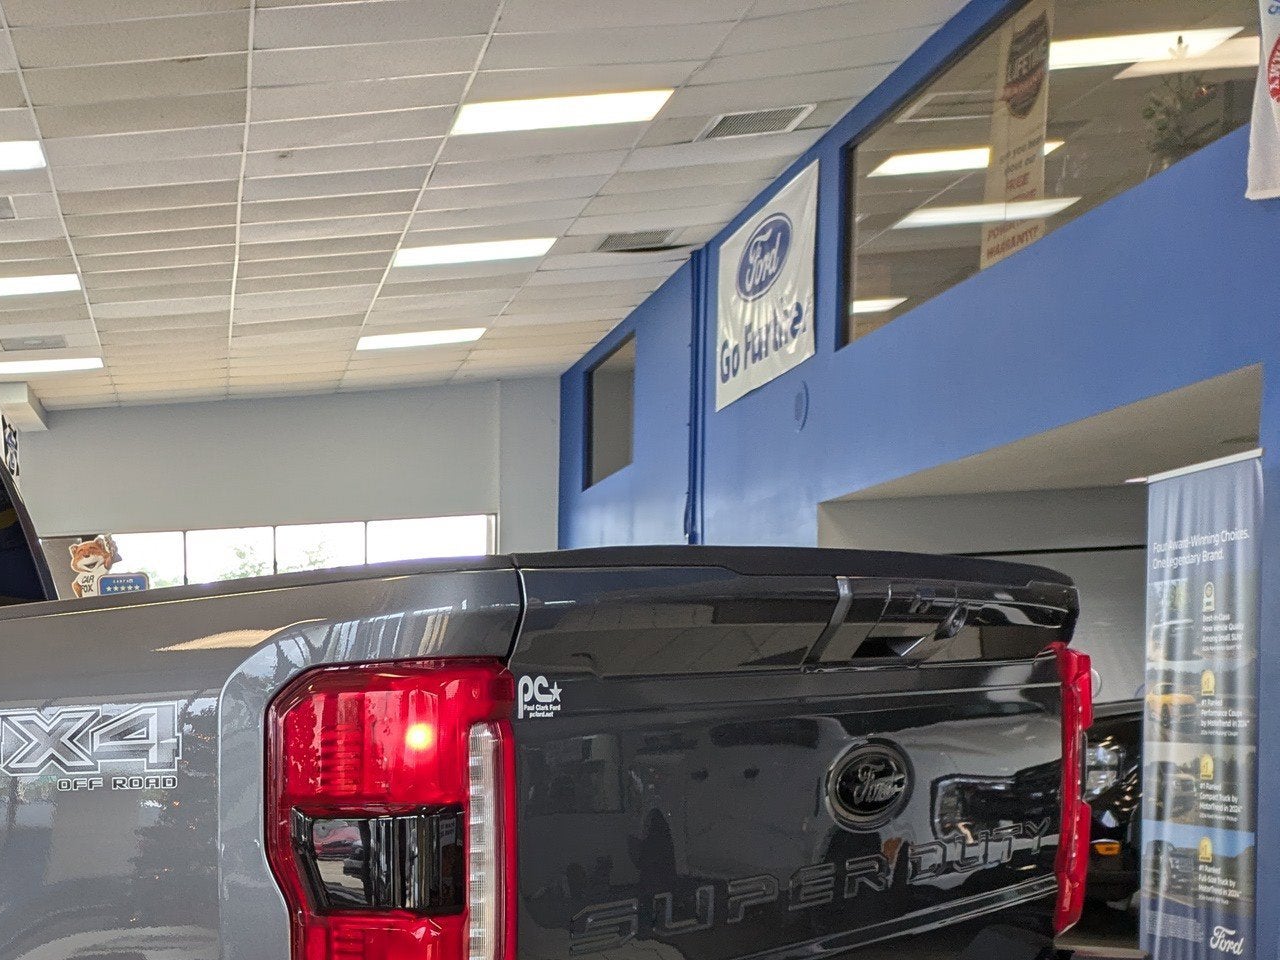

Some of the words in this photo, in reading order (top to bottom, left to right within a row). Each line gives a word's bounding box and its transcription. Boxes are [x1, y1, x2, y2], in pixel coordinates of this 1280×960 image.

[745, 228, 782, 292] Ford
[720, 339, 740, 384] Go
[57, 776, 104, 791] OFF
[112, 775, 179, 790] ROAD
[853, 763, 906, 806] Ford
[568, 853, 892, 957] SUPER
[908, 816, 1052, 887] DUTY
[1210, 925, 1245, 955] Ford
